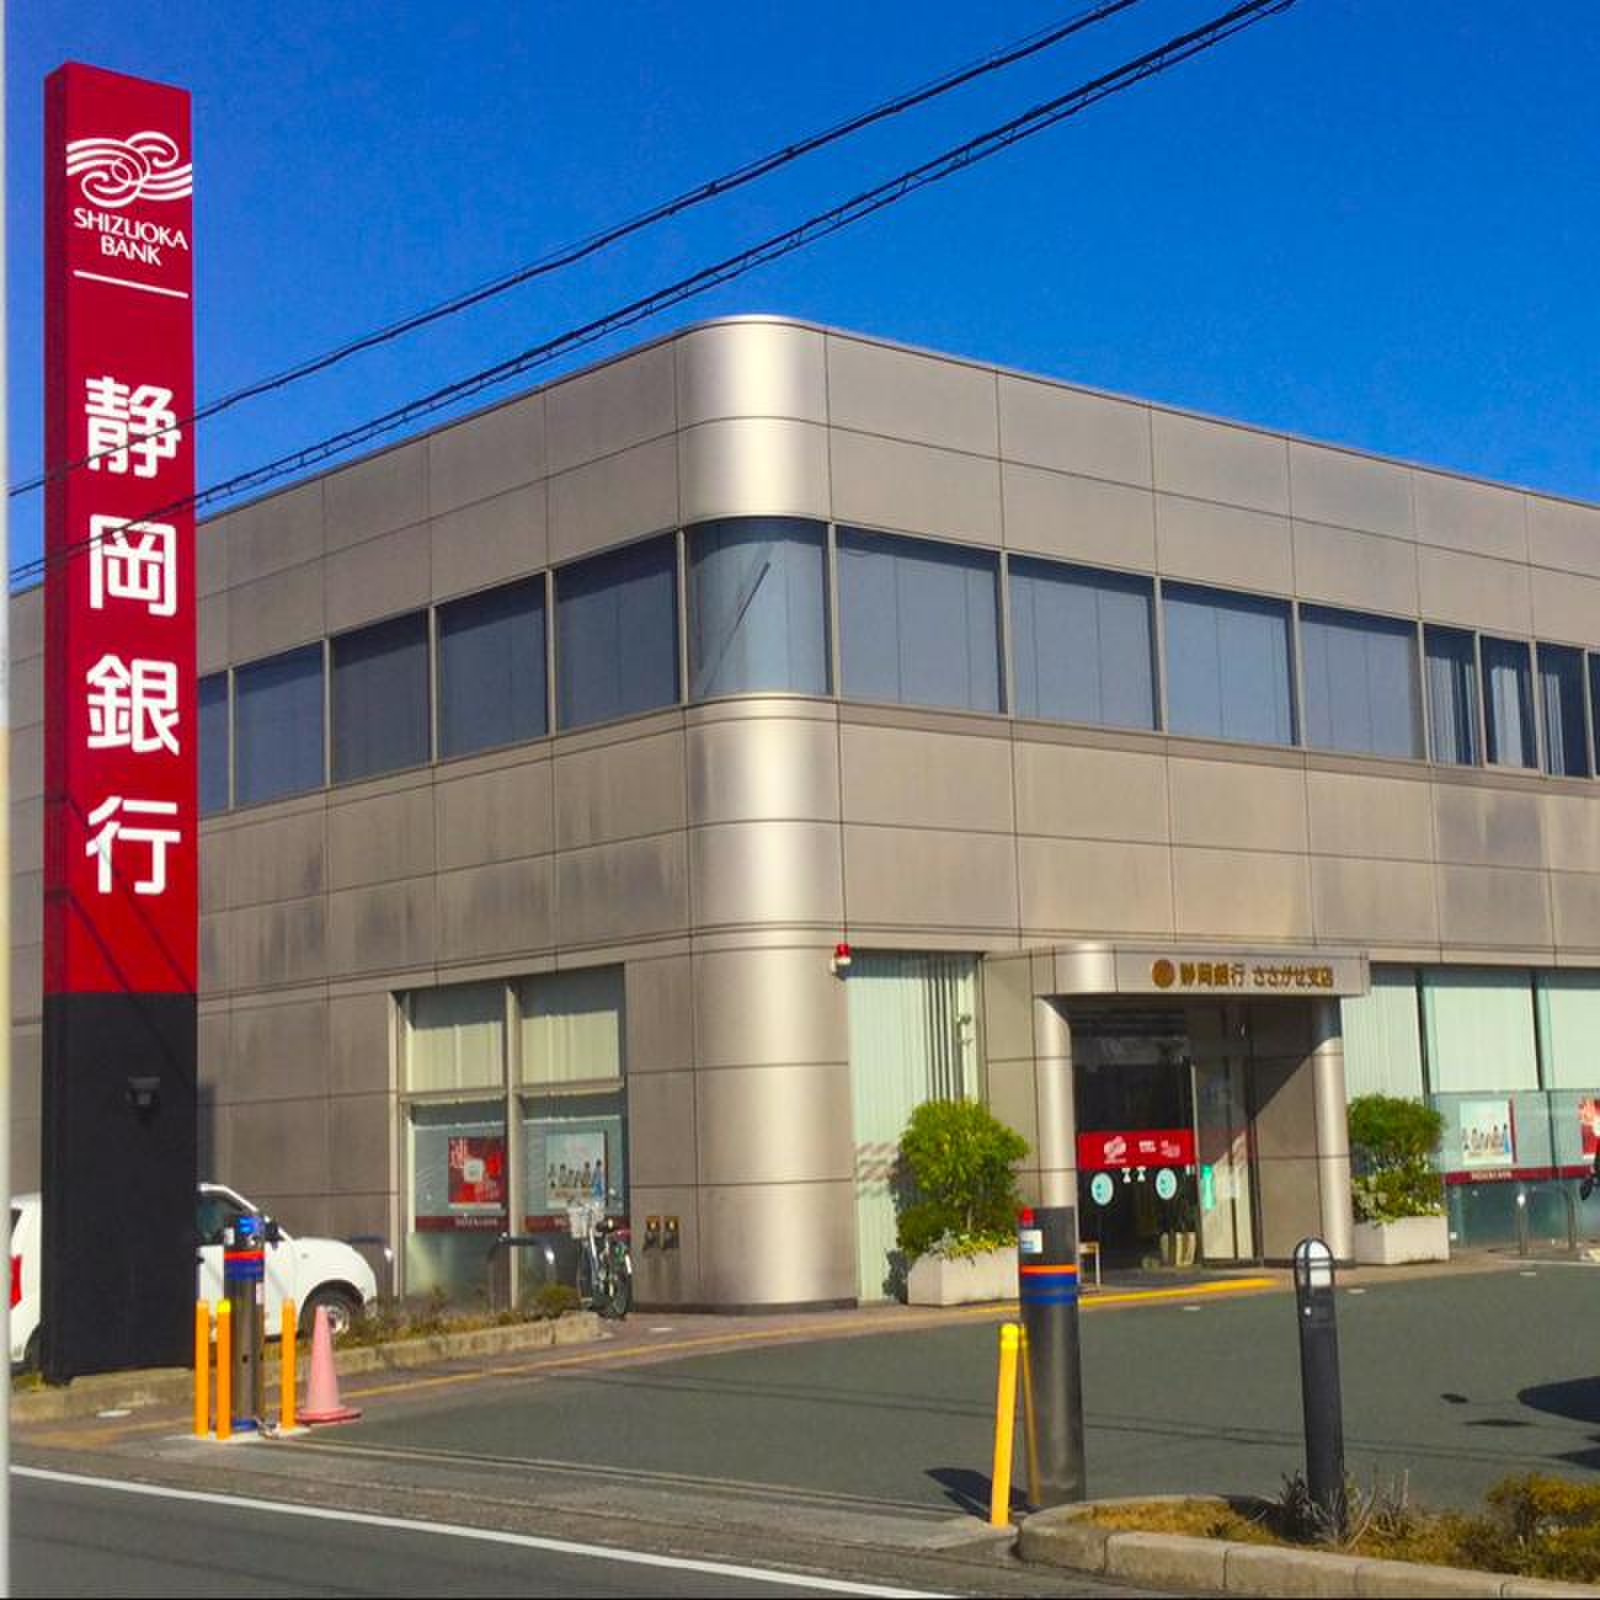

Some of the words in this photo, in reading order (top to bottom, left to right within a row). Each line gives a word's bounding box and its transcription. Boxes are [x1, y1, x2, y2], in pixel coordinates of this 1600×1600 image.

[74, 207, 188, 251] SHIZUOKA
[101, 235, 162, 266] BANK
[85, 375, 182, 894] 静岡銀行
